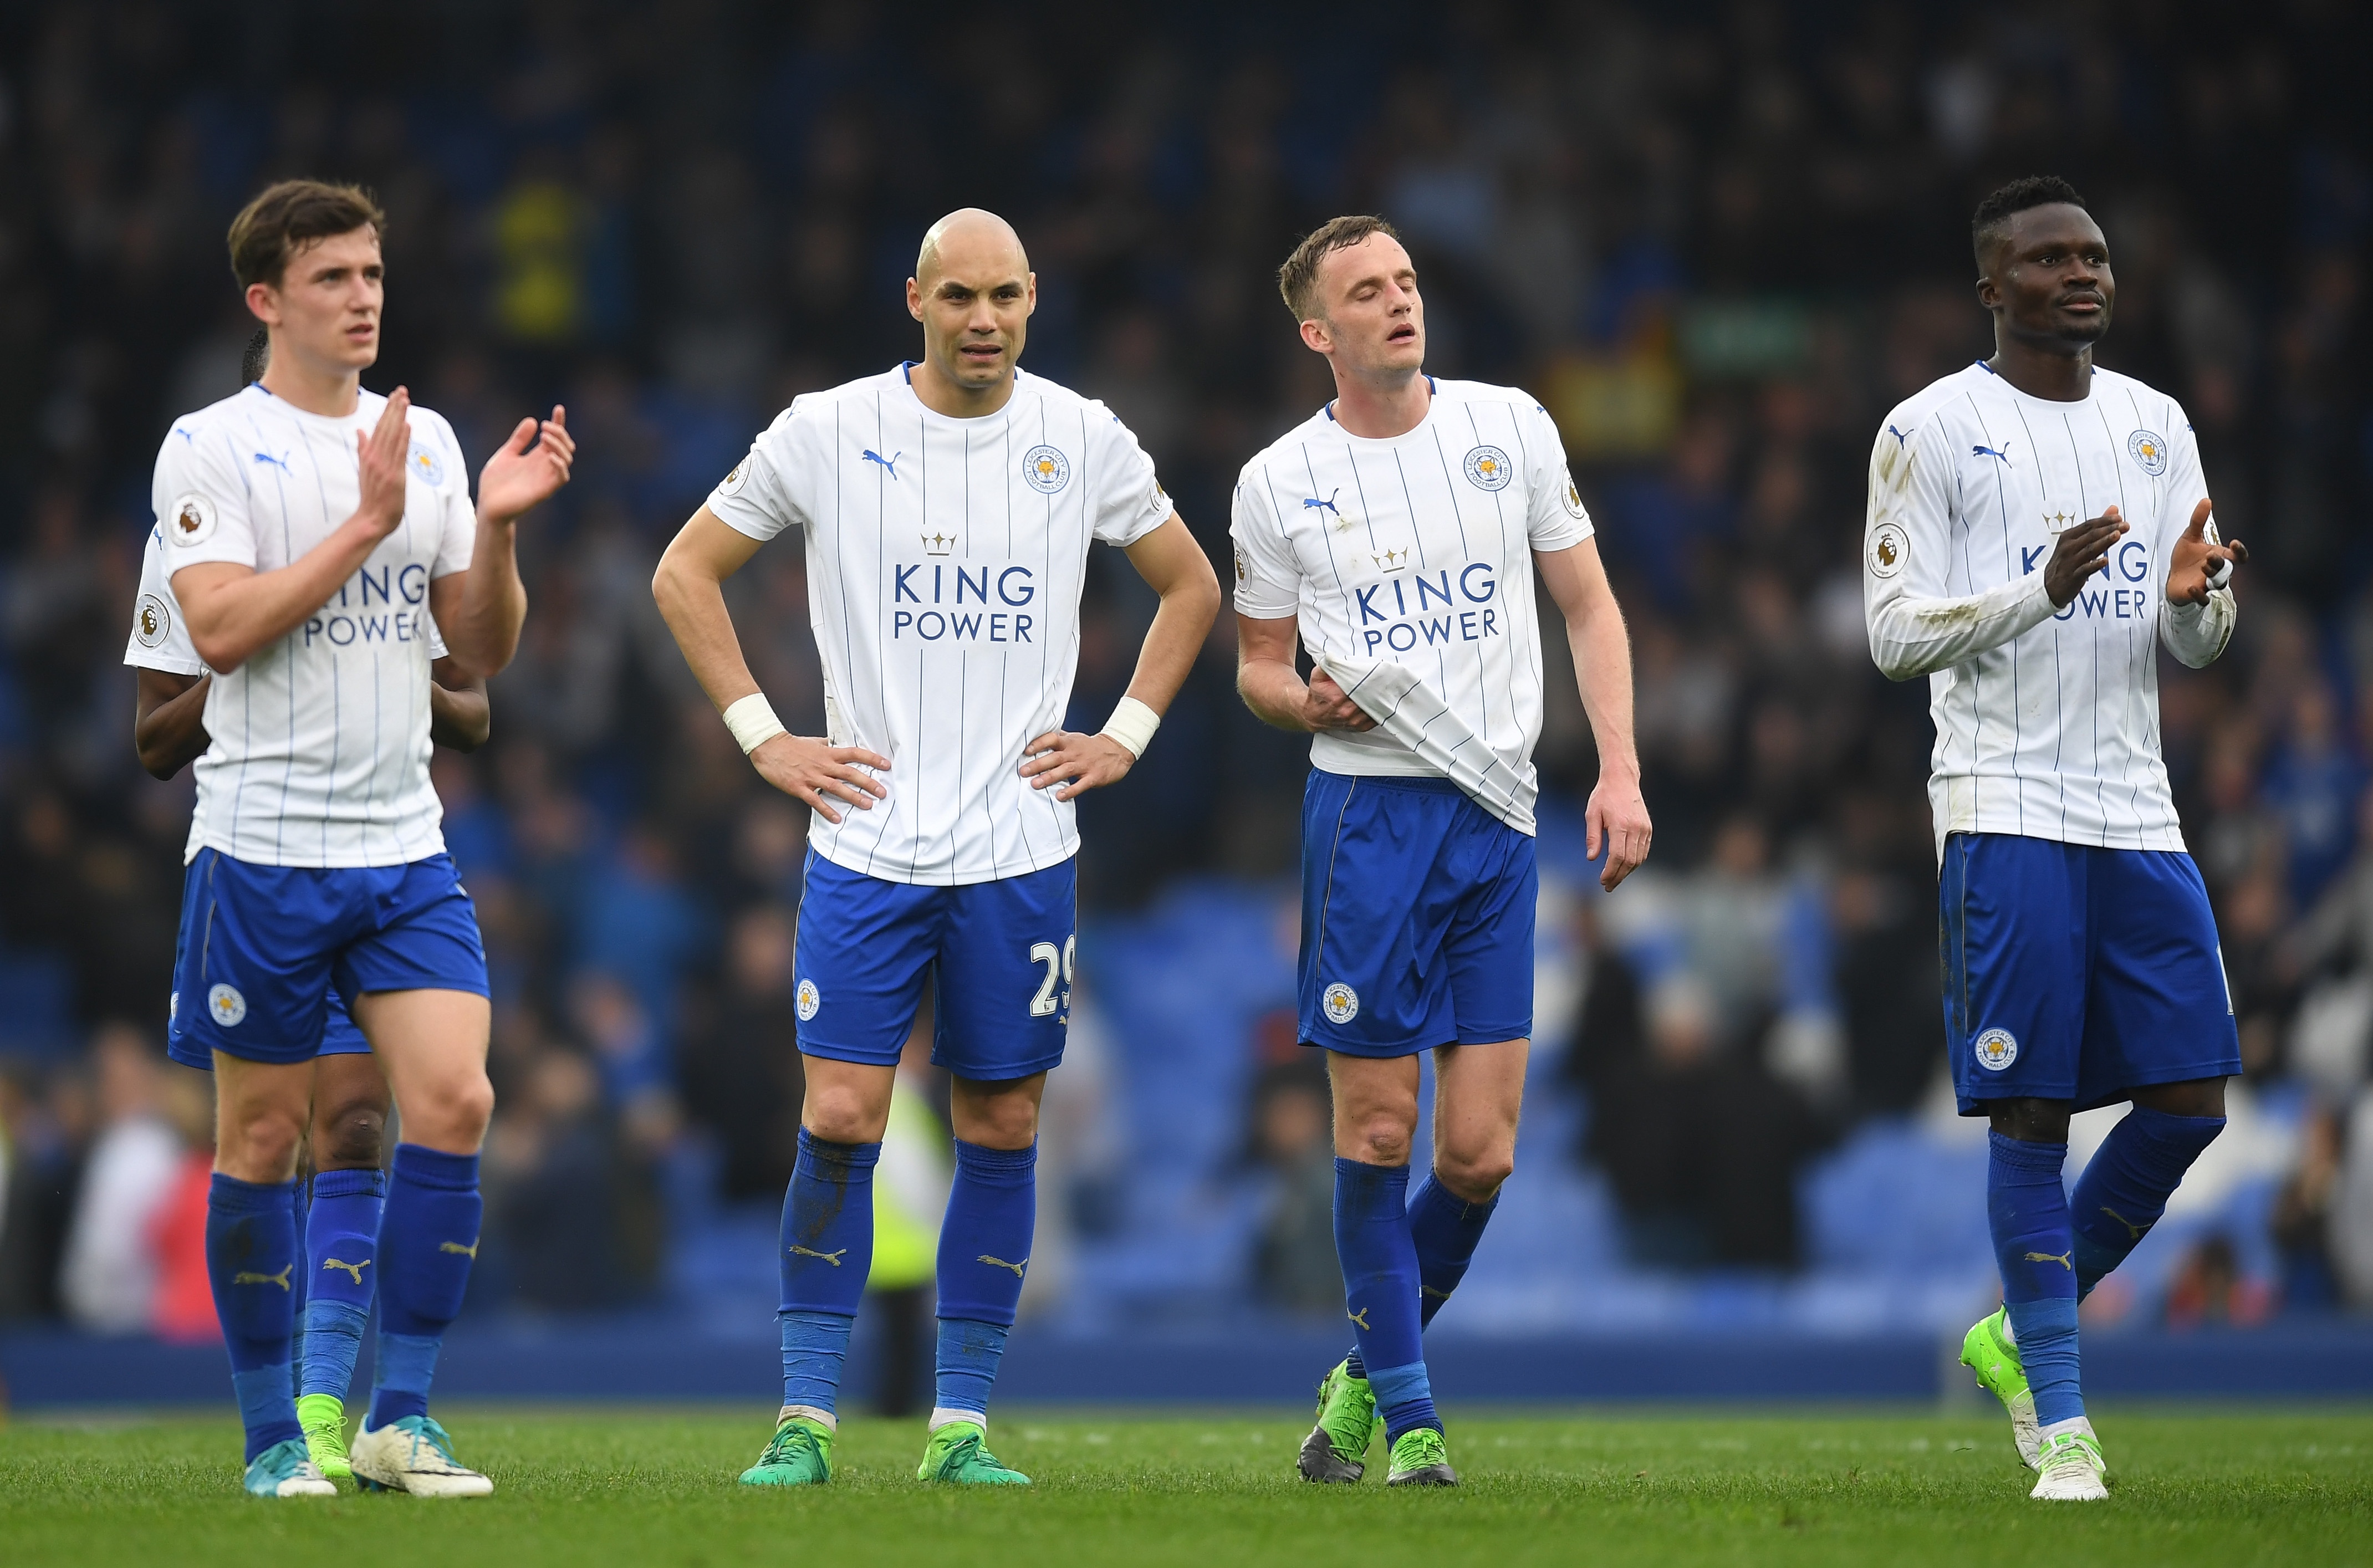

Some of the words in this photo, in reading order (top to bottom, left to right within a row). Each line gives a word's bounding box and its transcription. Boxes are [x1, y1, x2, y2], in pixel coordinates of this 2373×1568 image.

[2154, 439, 2164, 452] CITY
[1027, 450, 1055, 467] LEICESTER
[1055, 454, 1065, 468] CITY
[1468, 450, 1493, 469] LEICESTER
[1494, 452, 1507, 463] CITY
[1027, 471, 1056, 489] FOOTBALL
[1056, 471, 1066, 487] CLUB
[1469, 473, 1501, 487] FOOTBALL
[2021, 541, 2148, 582] KG
[324, 564, 426, 609] ING
[895, 564, 1035, 606] KING
[1355, 563, 1496, 626] KING
[2053, 590, 2146, 621] WER
[894, 611, 1033, 643] POWER
[1363, 609, 1499, 657] POWER
[1030, 934, 1075, 1017] 29
[1325, 985, 1350, 998] LEICESTER
[1344, 1008, 1355, 1020] CLUB
[1978, 1031, 2004, 1048] LEICESTER
[2005, 1035, 2014, 1046] CITY
[1978, 1051, 2004, 1068] FOOTBALL
[2003, 1050, 2014, 1064] CLUB
